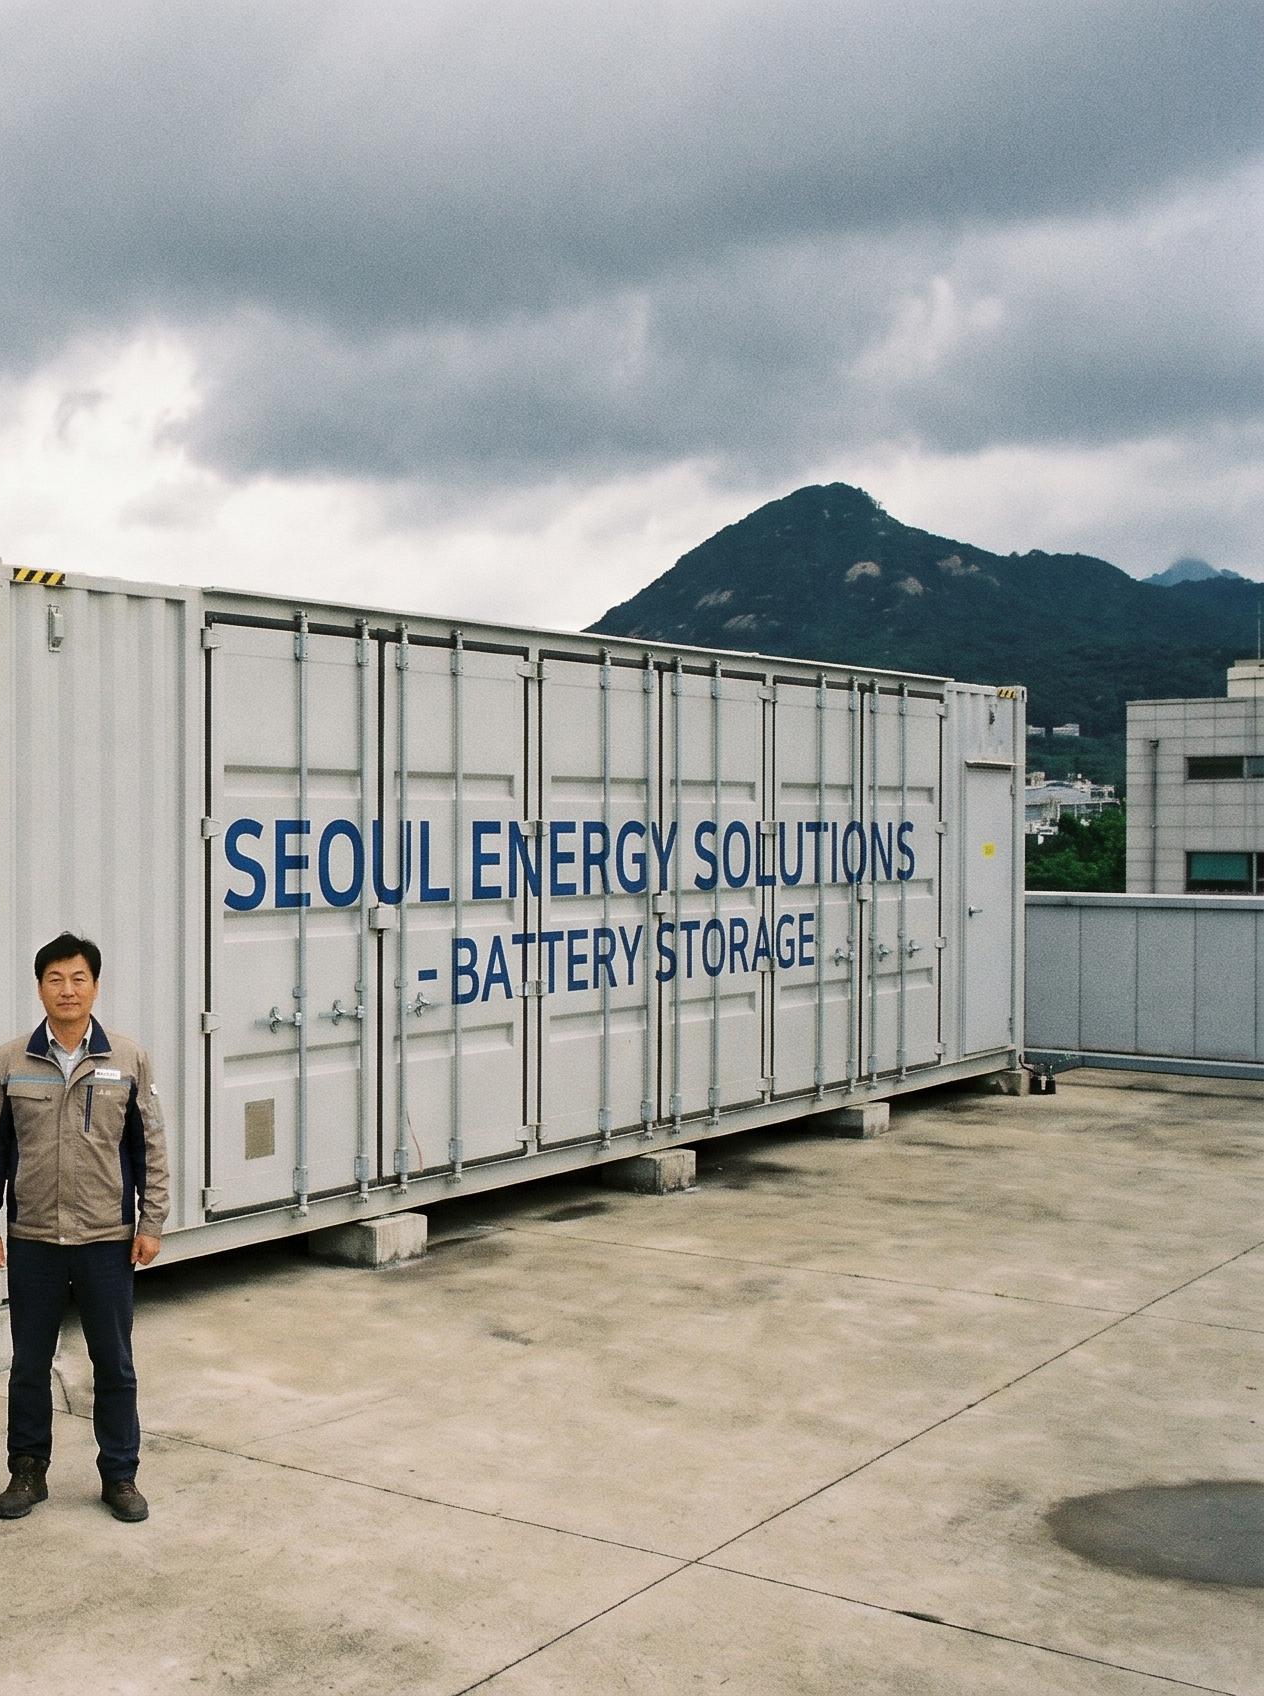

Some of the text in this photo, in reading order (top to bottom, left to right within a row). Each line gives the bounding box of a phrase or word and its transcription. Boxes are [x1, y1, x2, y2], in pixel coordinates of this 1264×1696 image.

[223, 818, 915, 911] SEOUL ENERGY SOLUTIONS
[451, 930, 643, 1005] BATTERY
[655, 912, 815, 982] STORAGE
